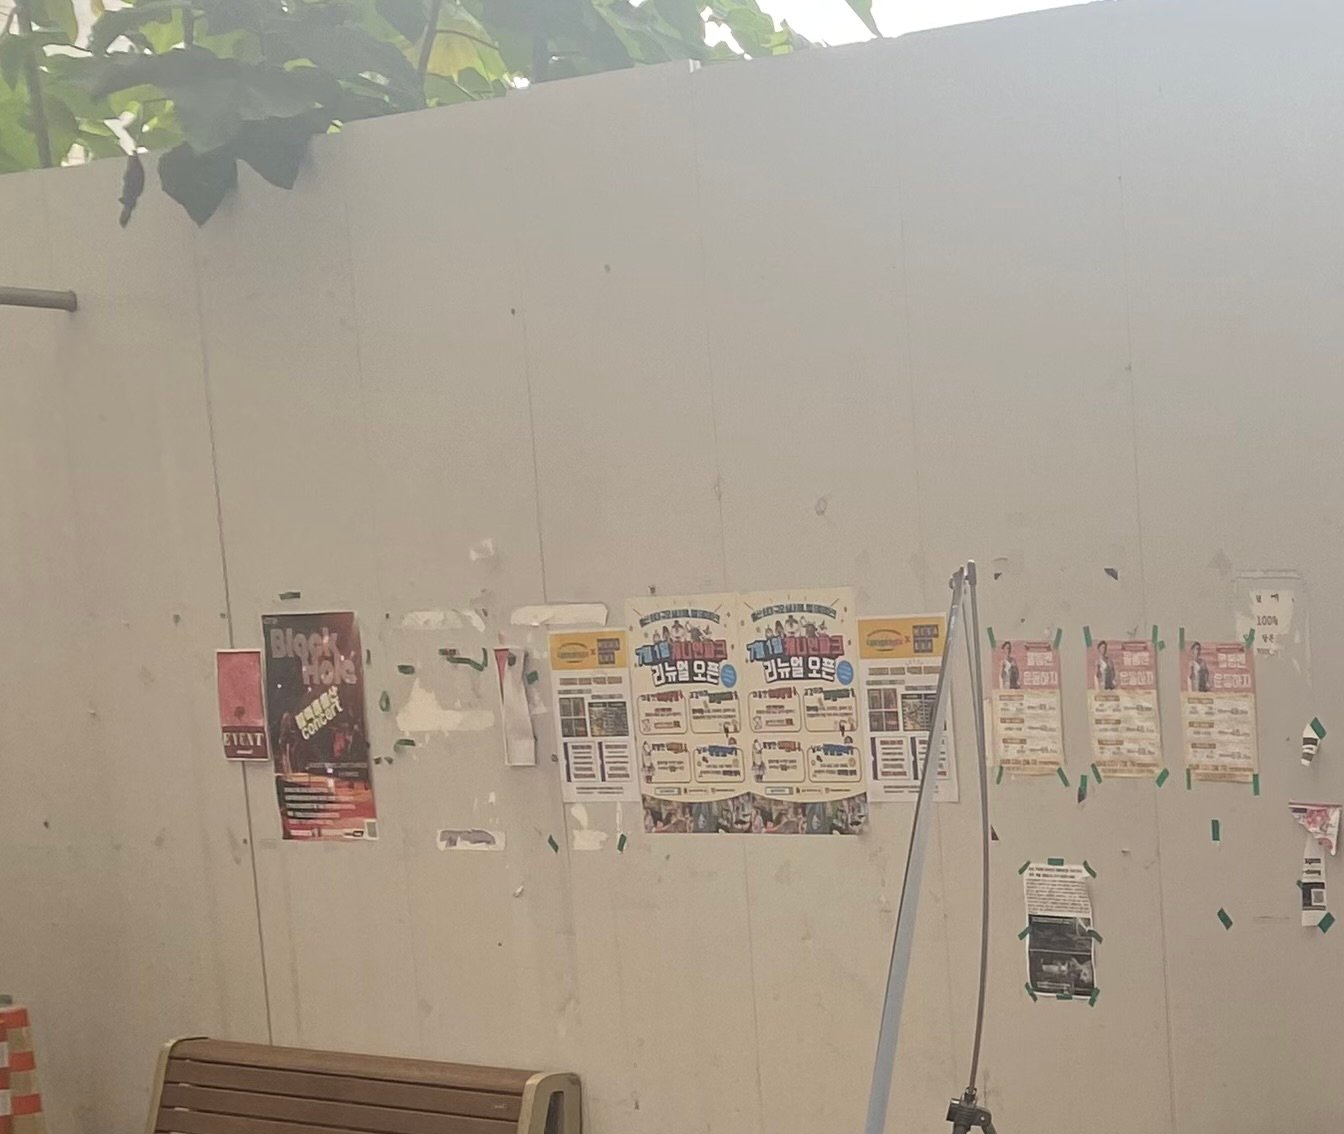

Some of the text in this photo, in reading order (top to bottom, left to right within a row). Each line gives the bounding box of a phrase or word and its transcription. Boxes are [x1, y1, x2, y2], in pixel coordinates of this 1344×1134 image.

[302, 655, 358, 685] Hole
[652, 660, 720, 686] 리뉴얼 오픈
[763, 656, 835, 682] 리뉴얼 오픈
[223, 732, 264, 747] EVENT
